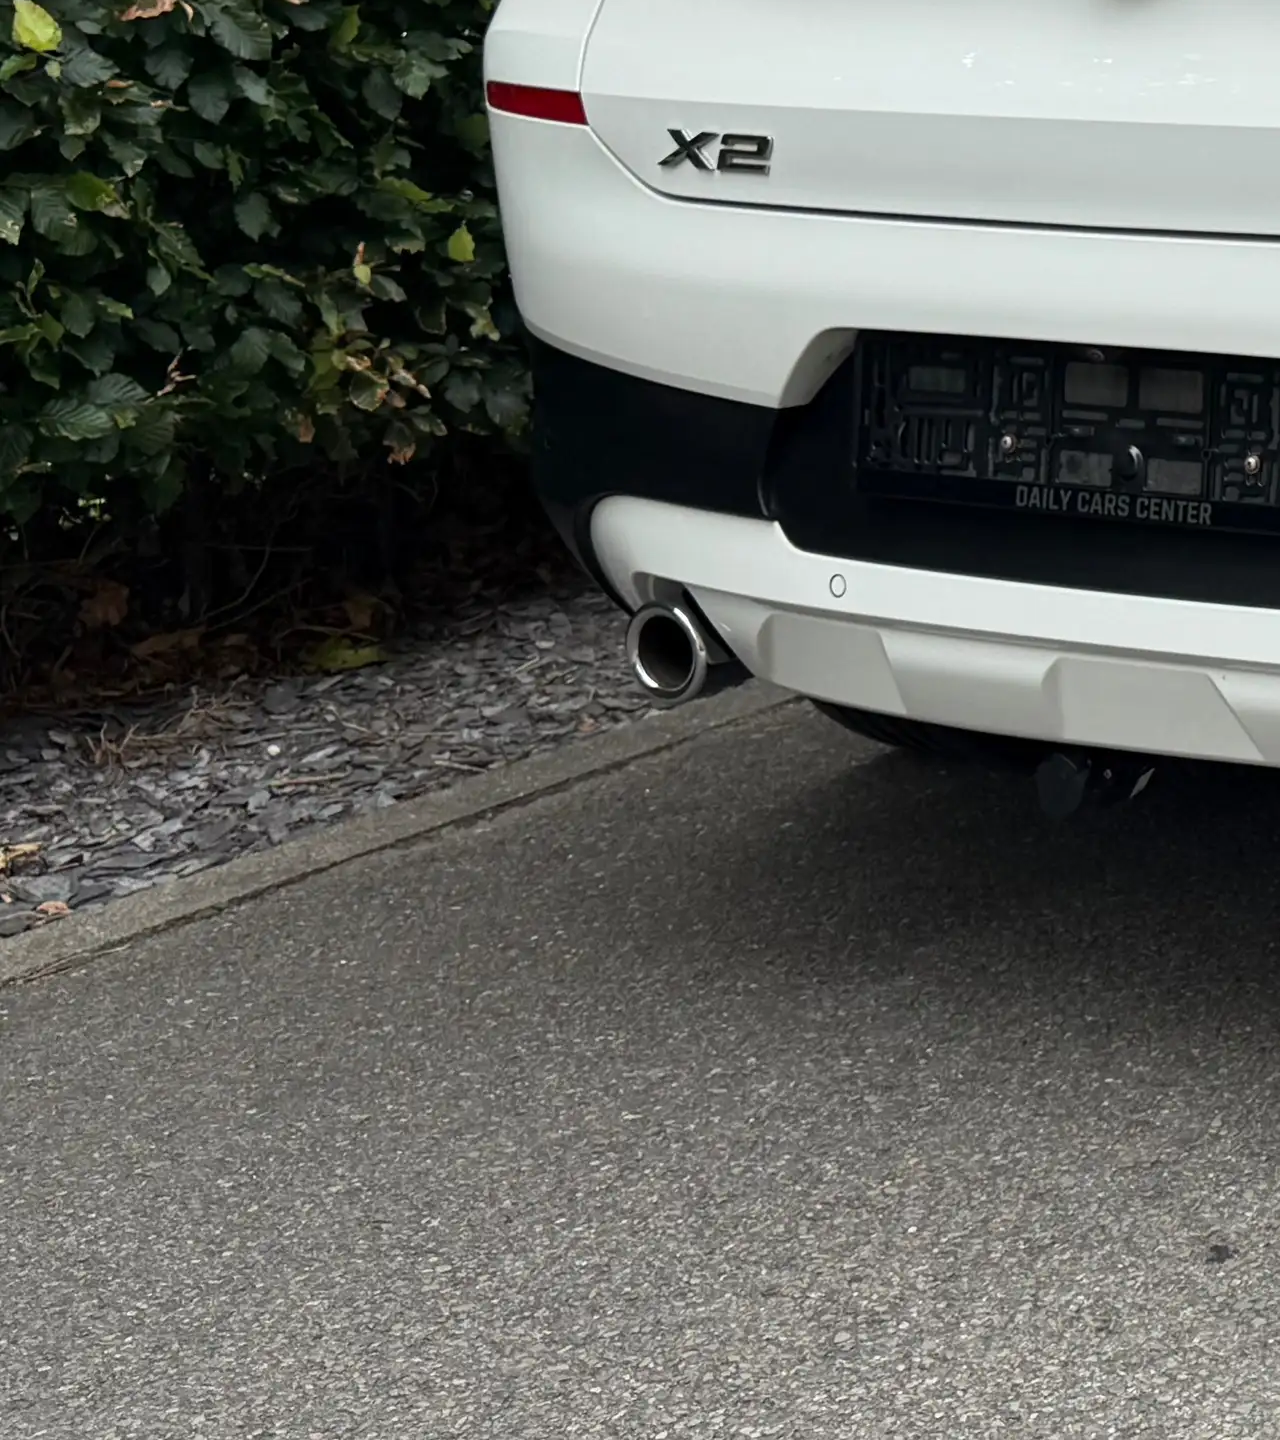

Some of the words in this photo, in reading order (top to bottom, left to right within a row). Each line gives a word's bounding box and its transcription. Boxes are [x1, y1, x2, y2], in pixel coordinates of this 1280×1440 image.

[657, 128, 774, 175] X2
[1016, 485, 1072, 511] DAILY
[1077, 489, 1129, 516] CARS
[1136, 498, 1212, 526] CENTER
